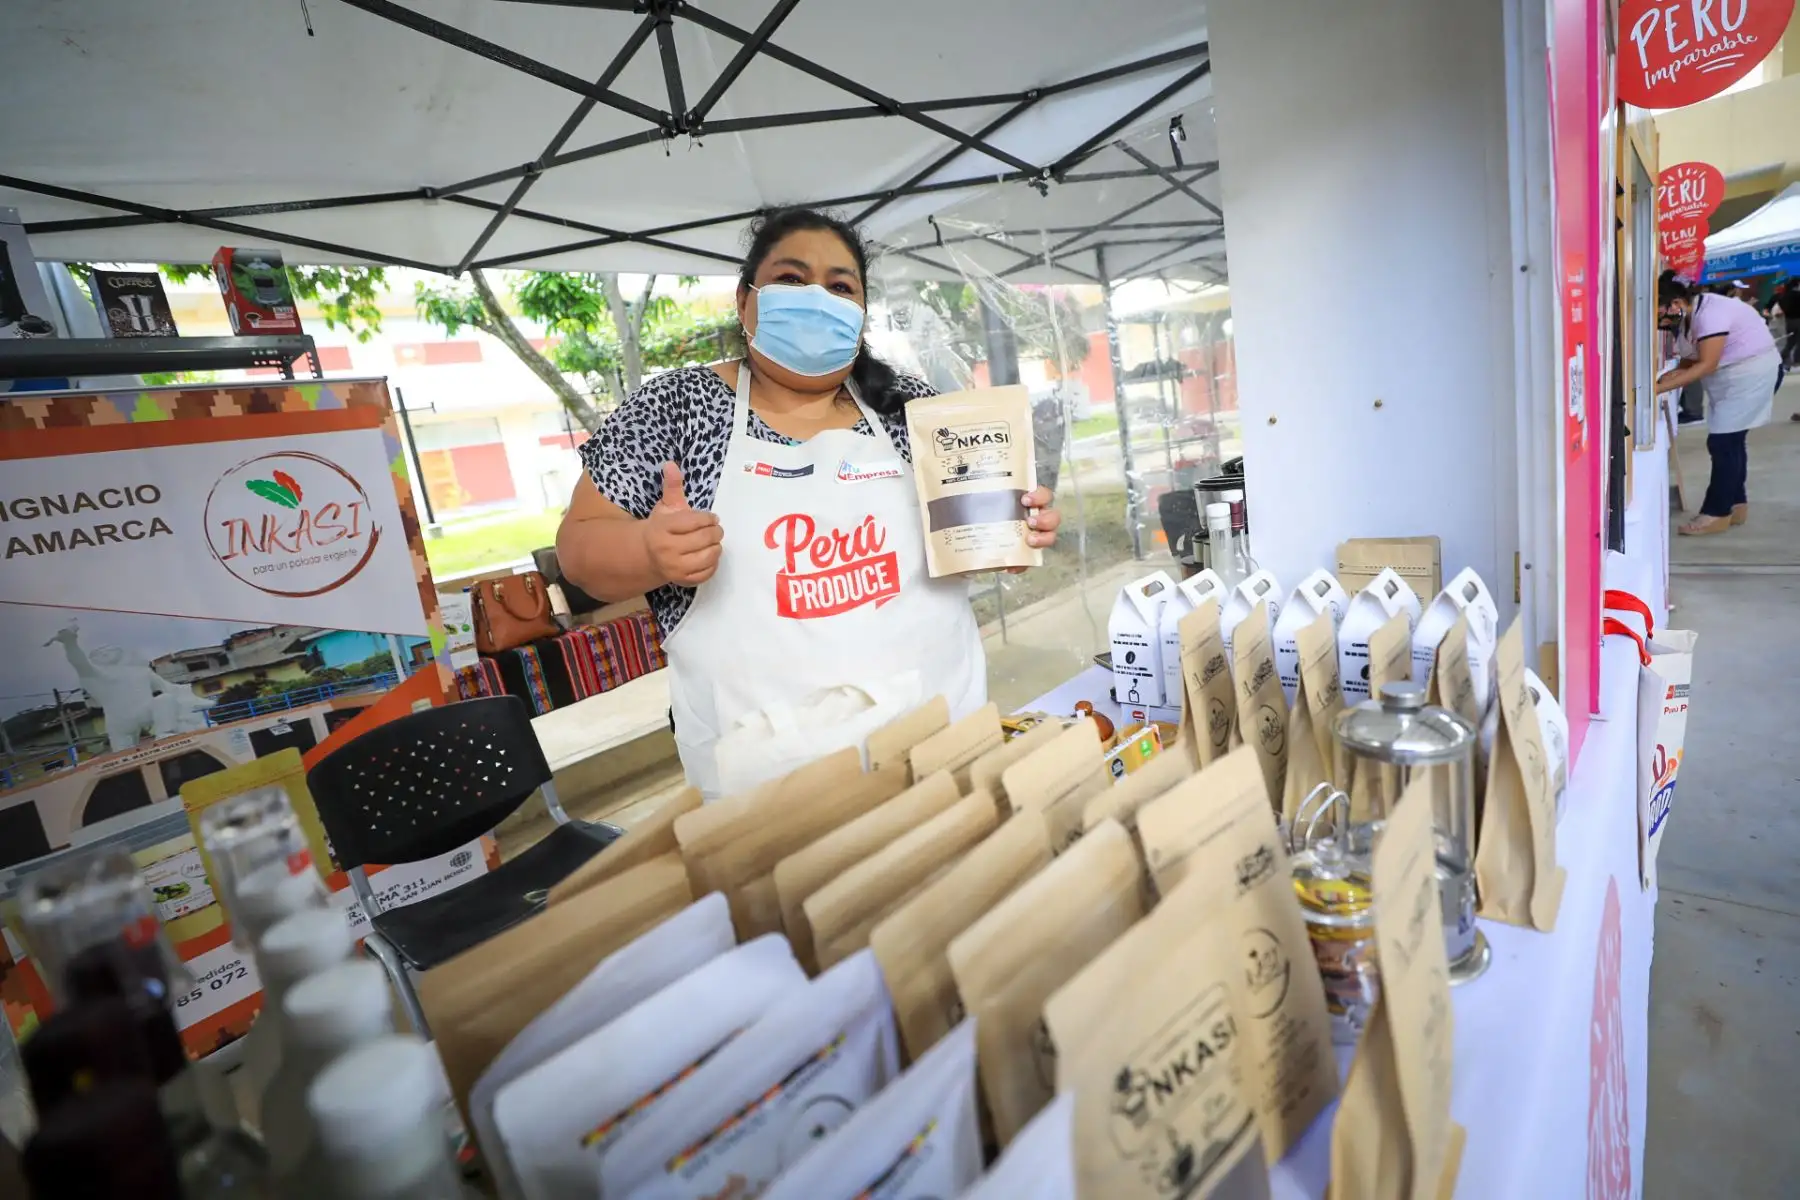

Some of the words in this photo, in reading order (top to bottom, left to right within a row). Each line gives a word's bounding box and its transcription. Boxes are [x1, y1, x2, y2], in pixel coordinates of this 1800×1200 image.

[1644, 33, 1758, 90] Imparable
[847, 469, 899, 481] Empresa
[0, 484, 161, 522] IGNACIO
[0, 517, 173, 560] AMARCA
[221, 502, 364, 561] INKASI
[764, 513, 886, 573] Perú
[252, 563, 275, 576] para
[788, 560, 892, 612] PRODUCE
[400, 891, 418, 905] SAN
[421, 878, 442, 894] JUAN
[403, 877, 427, 894] 311
[177, 987, 203, 1008] 85
[210, 966, 249, 991] 072
[196, 959, 242, 984] edidos
